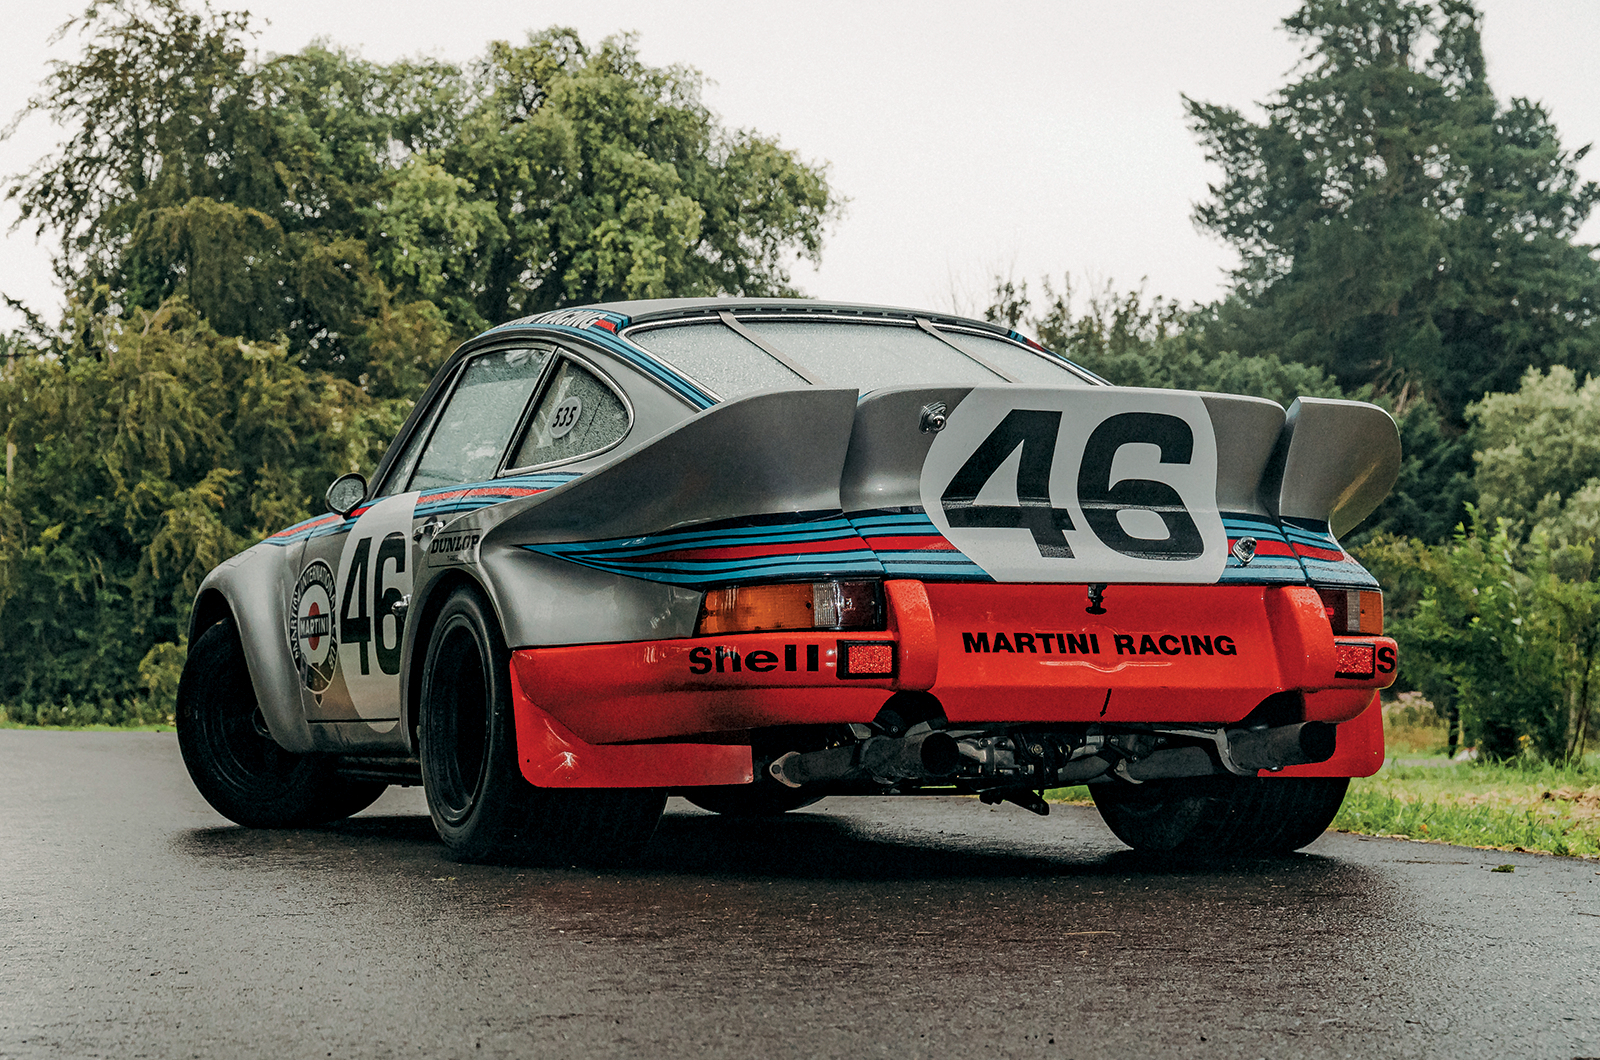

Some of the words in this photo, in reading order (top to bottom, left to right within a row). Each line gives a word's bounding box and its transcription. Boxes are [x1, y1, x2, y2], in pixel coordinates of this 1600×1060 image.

[552, 406, 578, 428] 535
[940, 409, 1205, 561] 46
[430, 534, 480, 554] DUNLOP
[340, 531, 407, 675] 46
[300, 615, 329, 637] MARTINI
[962, 631, 1100, 655] MARTINI
[1115, 634, 1237, 657] RACING
[688, 644, 819, 675] Shell
